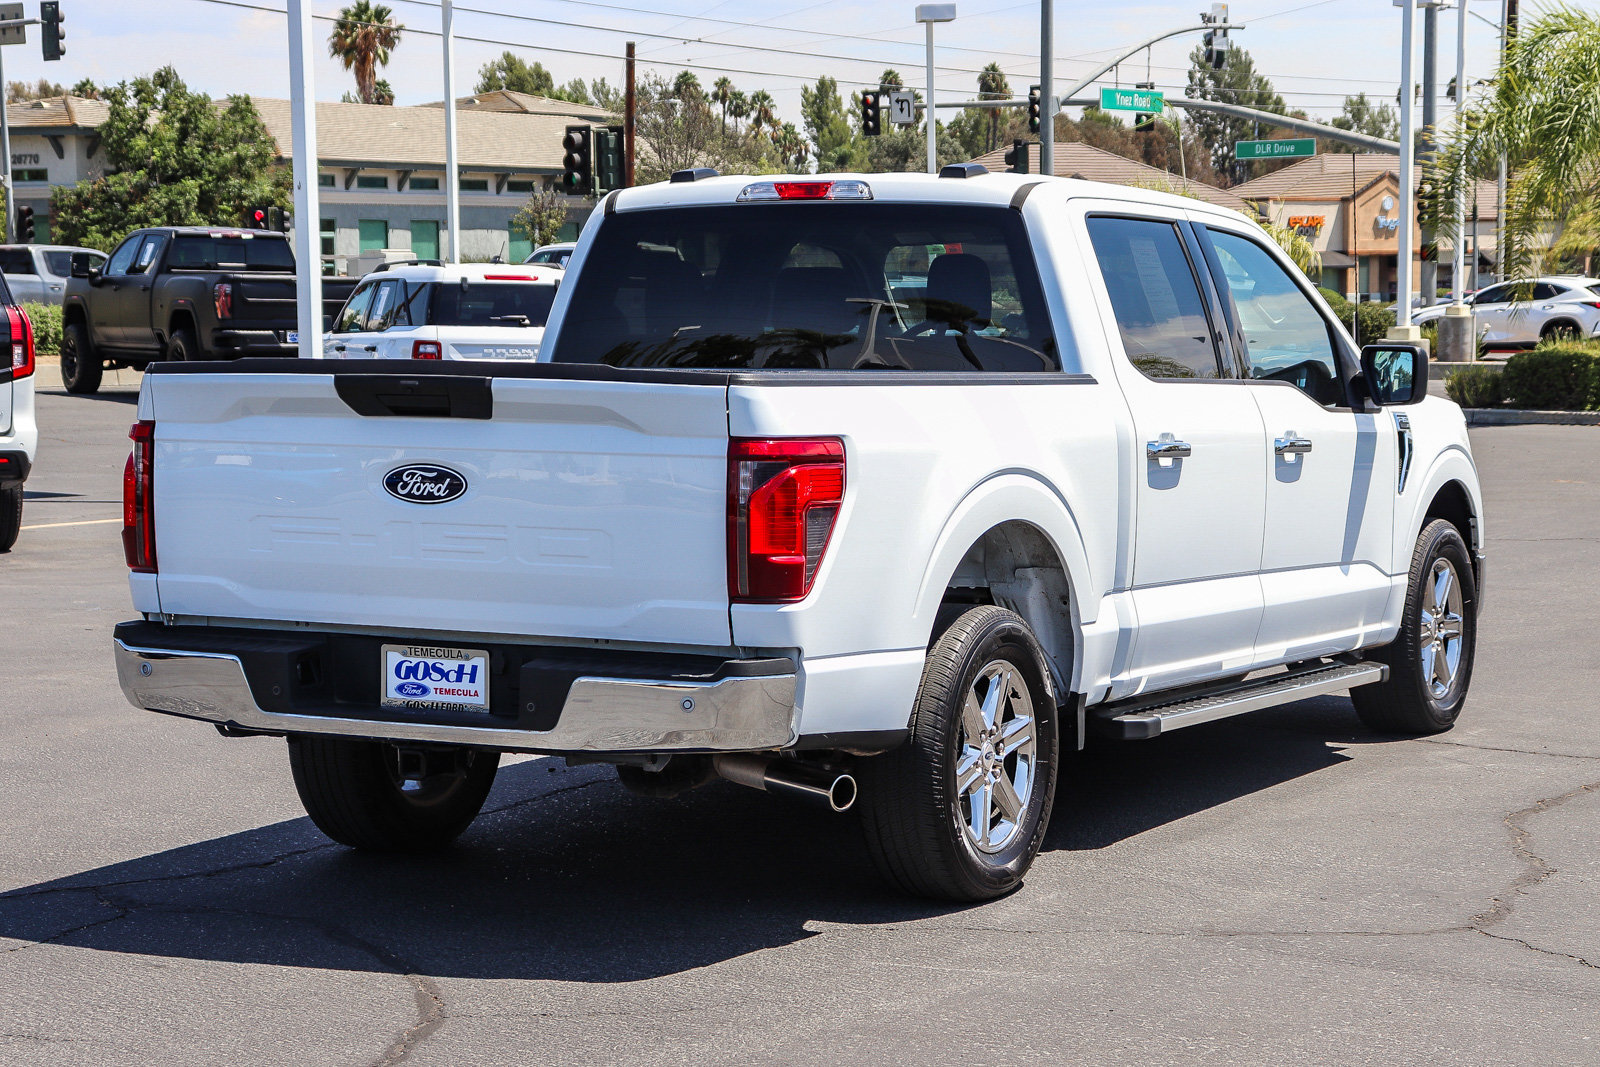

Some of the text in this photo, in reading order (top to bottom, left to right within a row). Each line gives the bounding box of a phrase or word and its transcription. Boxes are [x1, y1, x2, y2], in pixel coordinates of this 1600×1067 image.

[1116, 92, 1151, 107] Ynez Road
[1255, 142, 1295, 154] DLR Drive
[397, 469, 451, 497] Ford
[407, 647, 464, 659] TEMECULA
[402, 684, 423, 695] Ford
[433, 687, 480, 698] TEMECULA
